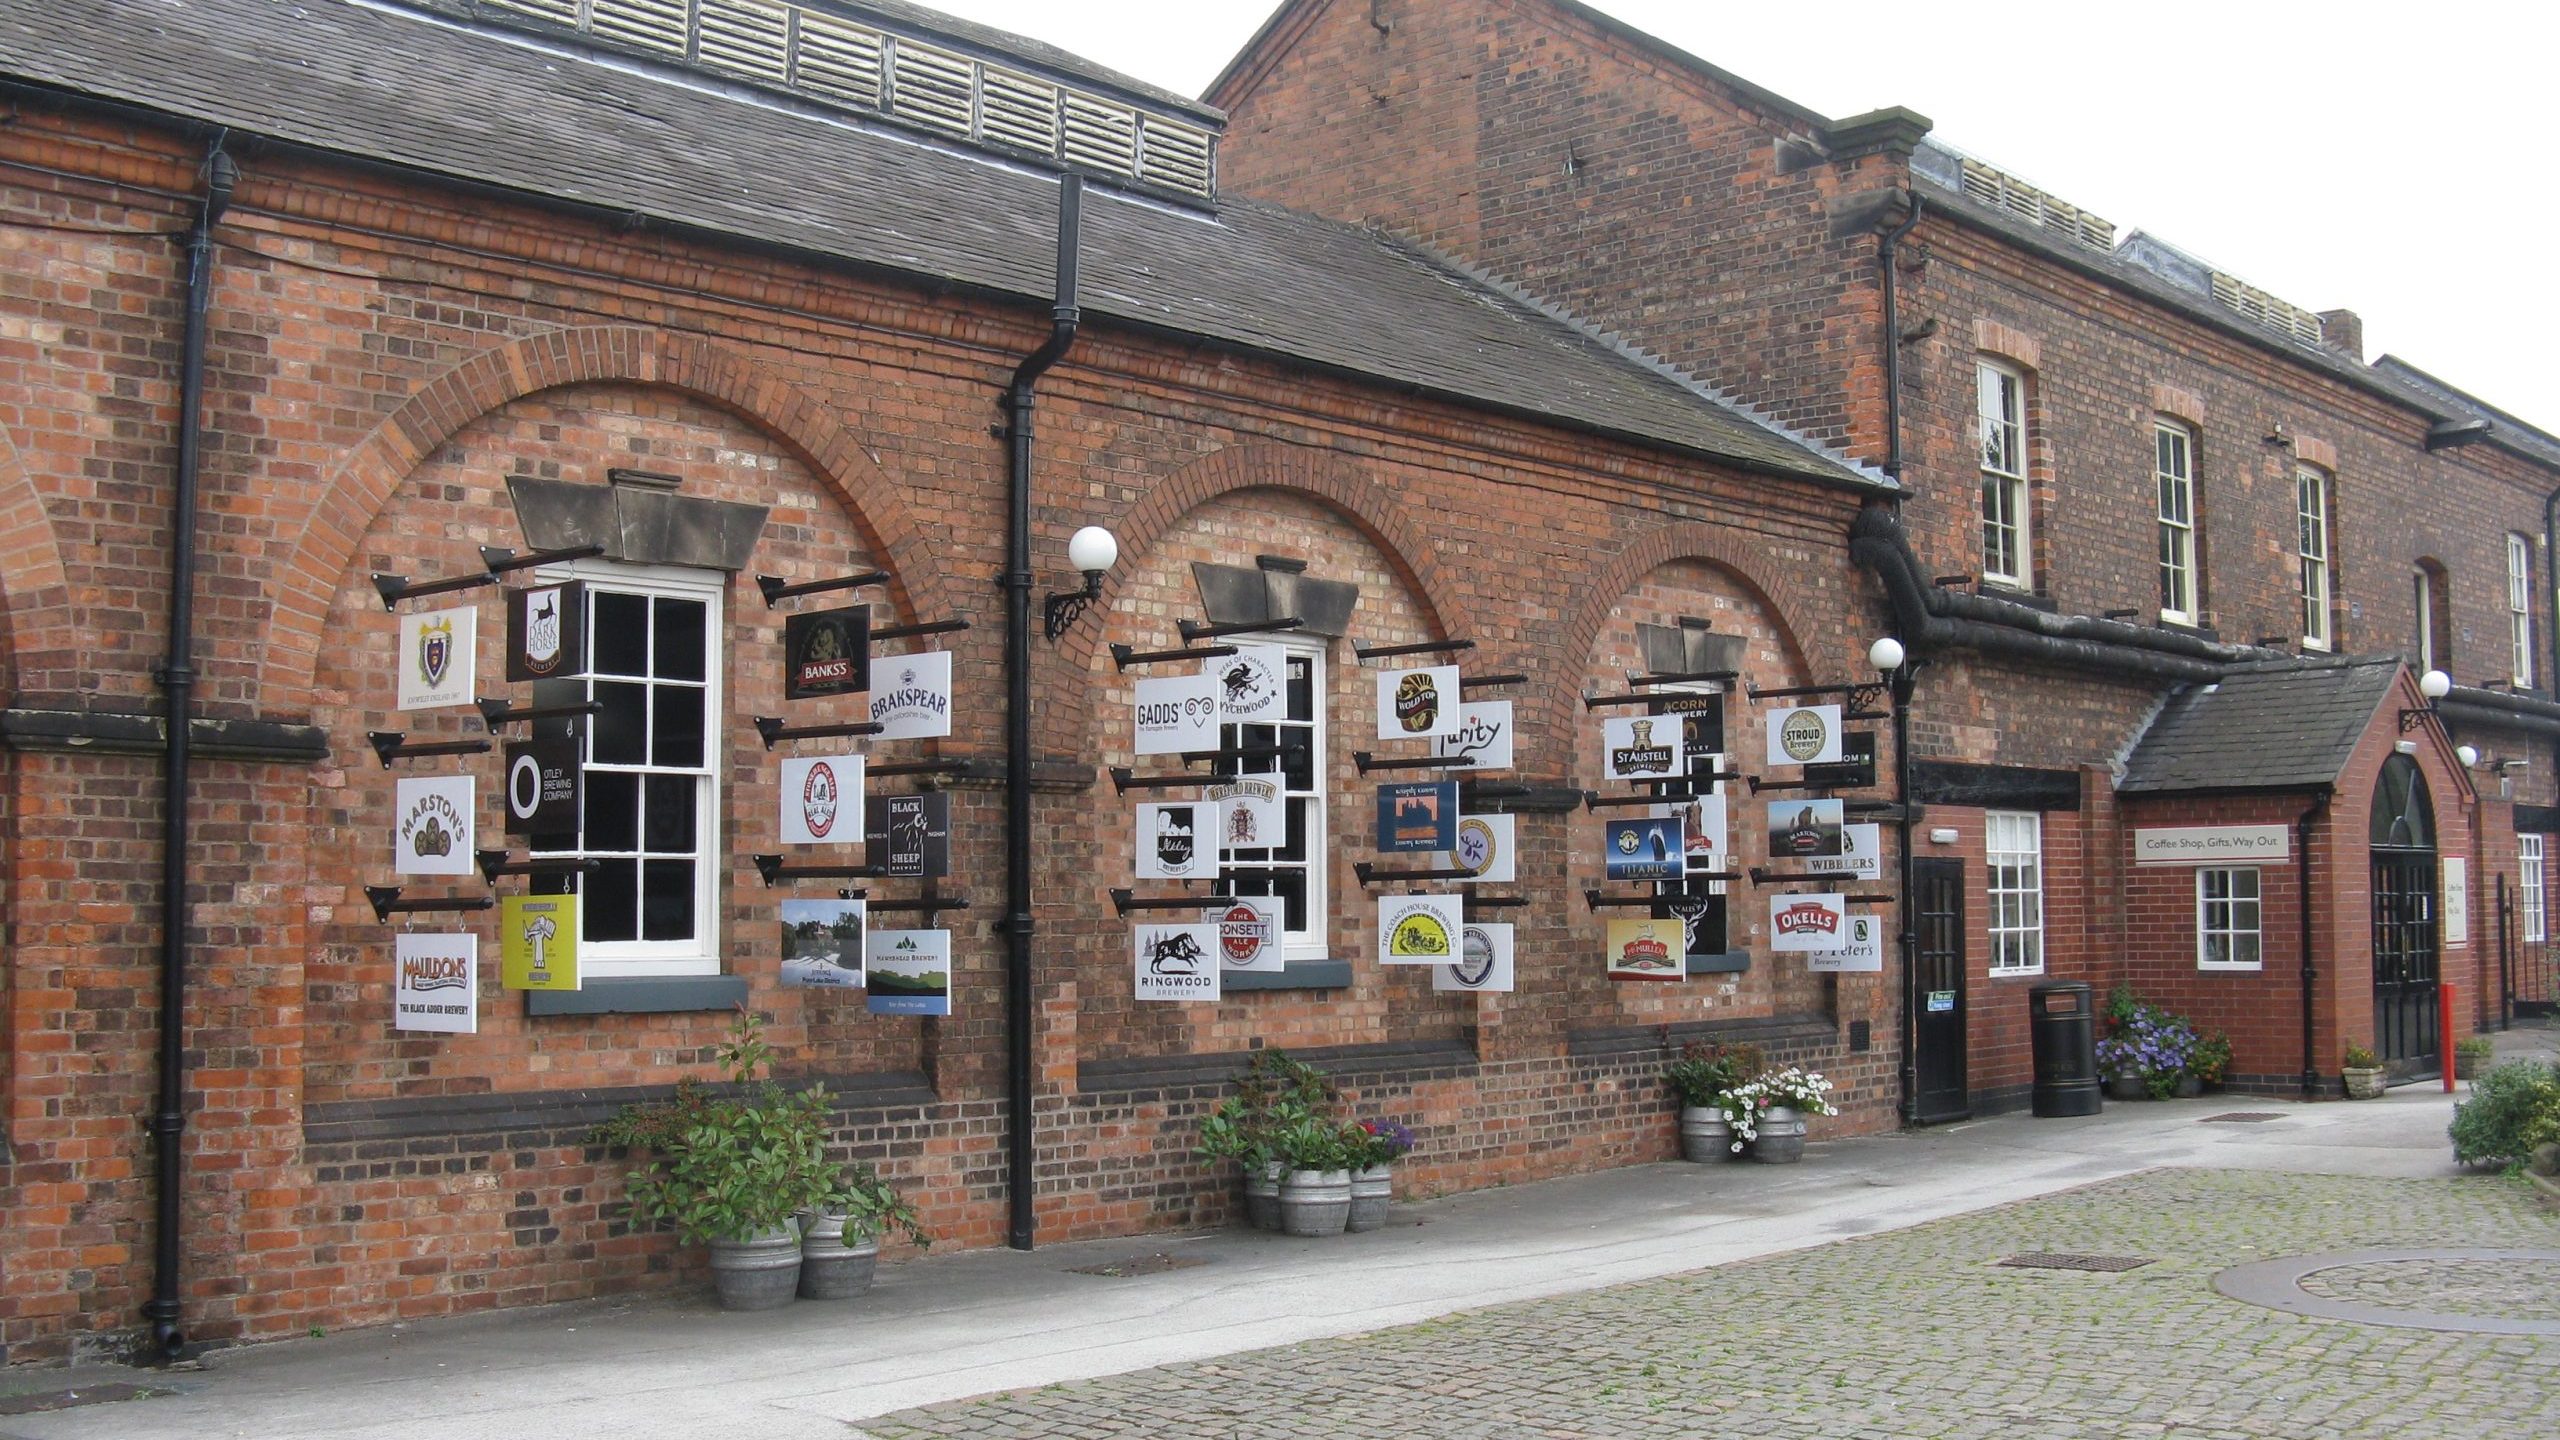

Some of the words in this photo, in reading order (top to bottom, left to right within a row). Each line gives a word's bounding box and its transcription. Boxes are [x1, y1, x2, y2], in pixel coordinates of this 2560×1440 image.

[530, 624, 557, 640] DARK
[529, 640, 557, 652] HORSE
[805, 662, 847, 679] BANKS'S
[1244, 655, 1274, 683] CHARACTER
[870, 688, 947, 720] BRAKSPEAR
[1398, 696, 1420, 710] WOLD
[1421, 690, 1436, 701] TOP
[1663, 699, 1707, 710] ACORN
[1138, 702, 1182, 725] GADDS'
[1786, 729, 1820, 741] STROUD
[1790, 740, 1817, 748] Brewery
[1629, 752, 1668, 763] AUSTELL
[1630, 763, 1657, 772] BREWERY
[544, 768, 563, 780] OTLEY
[544, 779, 572, 790] BREWING
[1245, 782, 1274, 798] BREWERY
[544, 790, 573, 801] COMPANY
[892, 802, 920, 813] BLACK
[402, 794, 464, 842] MARSTON'S
[2146, 839, 2177, 849] Coffee
[2180, 838, 2205, 850] Shop,
[2207, 837, 2232, 848] Gifts,
[2232, 836, 2254, 848] Way
[2257, 836, 2277, 846] Out
[892, 854, 920, 863] SHEEP
[1812, 859, 1874, 870] WIBBLERS
[1622, 864, 1668, 874] TITANIC
[1382, 930, 1390, 948] THE
[1387, 908, 1407, 930] COACH
[1407, 902, 1430, 912] HOUSE
[1430, 906, 1455, 938] BREWING
[1782, 912, 1832, 928] OKELLS
[1227, 944, 1255, 957] WORKS
[402, 955, 466, 990] MAULDONS
[1142, 978, 1211, 986] RINGWOOD
[400, 1004, 409, 1013] THE
[410, 1004, 425, 1013] BLACK
[427, 1005, 442, 1014] ADDER
[445, 1005, 468, 1015] BREWERY
